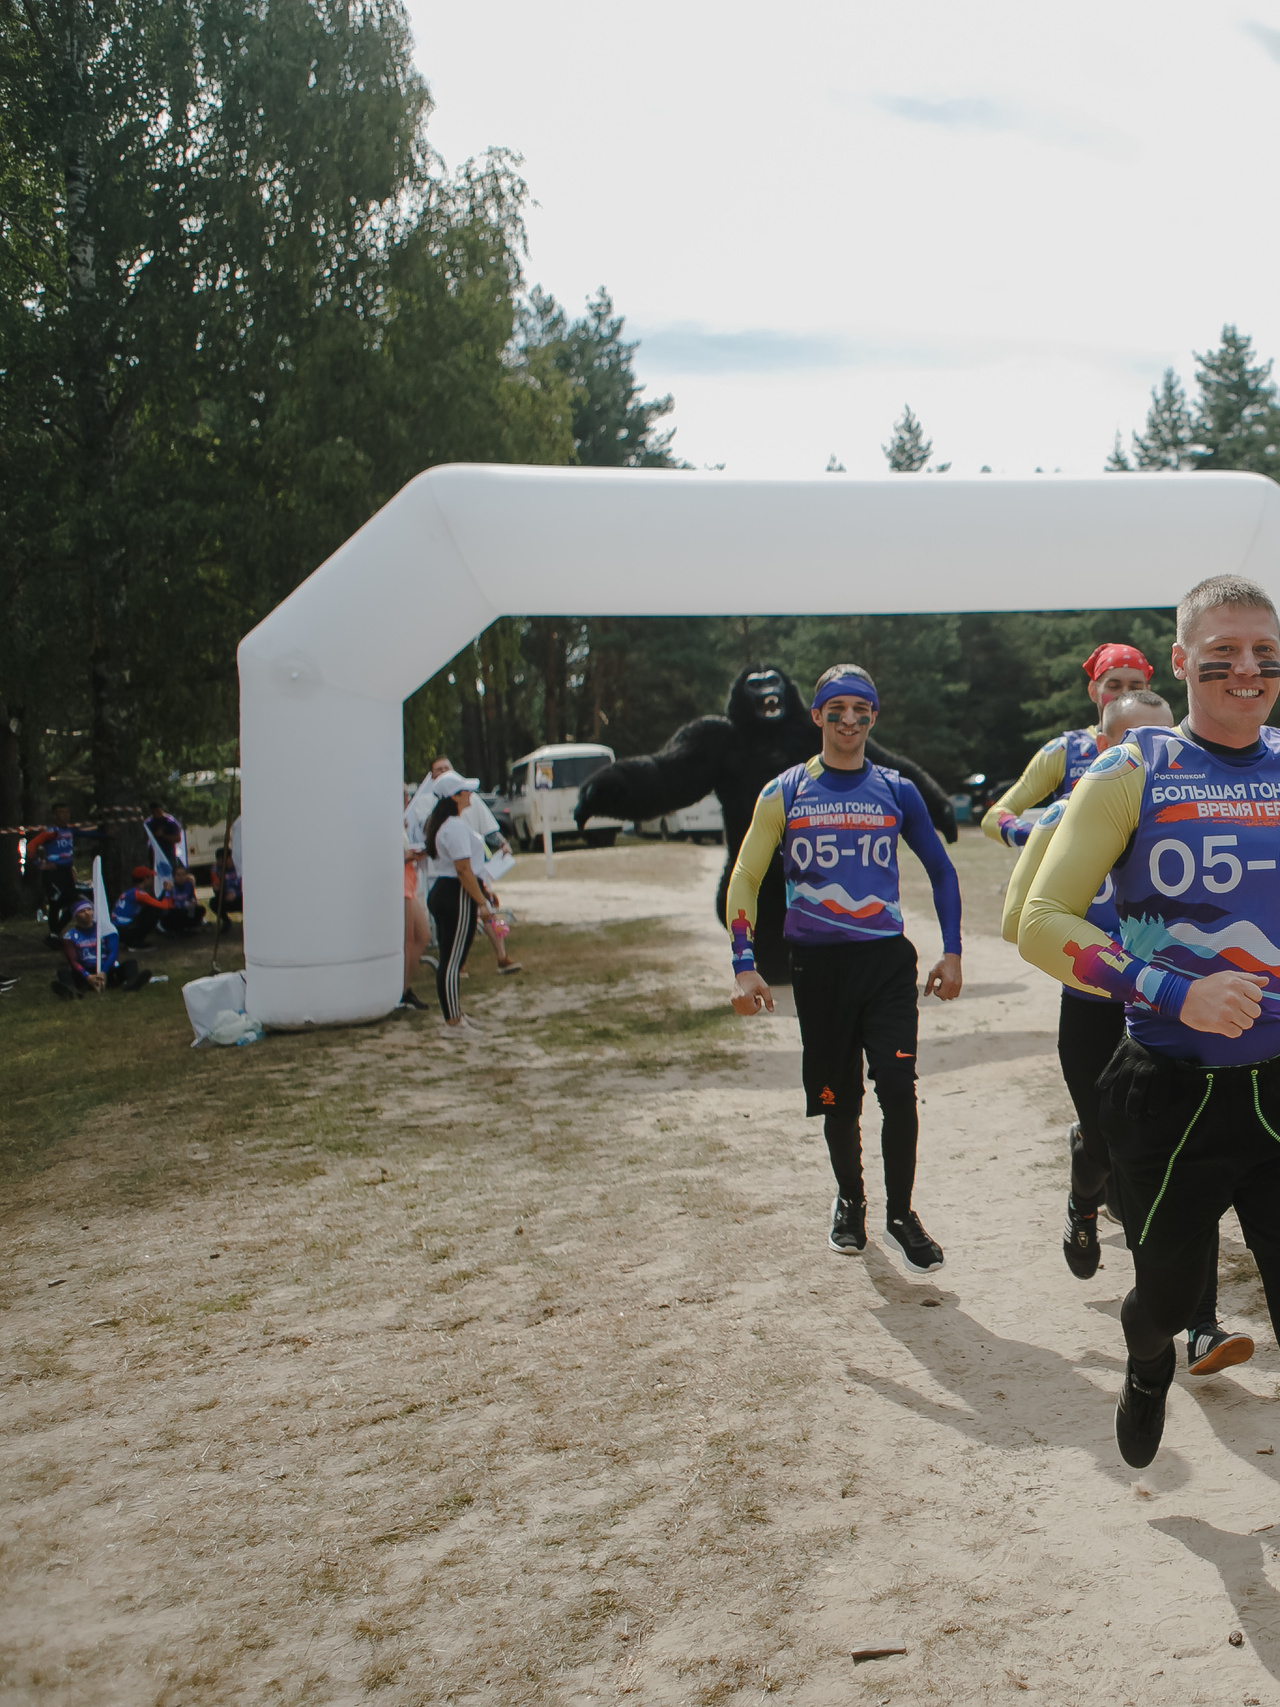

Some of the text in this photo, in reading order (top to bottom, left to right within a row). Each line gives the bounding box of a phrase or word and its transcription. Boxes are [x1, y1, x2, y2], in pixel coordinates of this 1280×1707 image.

[1153, 772, 1206, 780] Ростелеком
[1151, 784, 1247, 804] БОЛЬШАЯ
[845, 802, 883, 815] ГОНКА
[1197, 802, 1253, 818] ВРЕМЯ
[809, 813, 885, 826] ВРЕМЯ ГЕРОЕВ
[791, 834, 891, 871] 05-10
